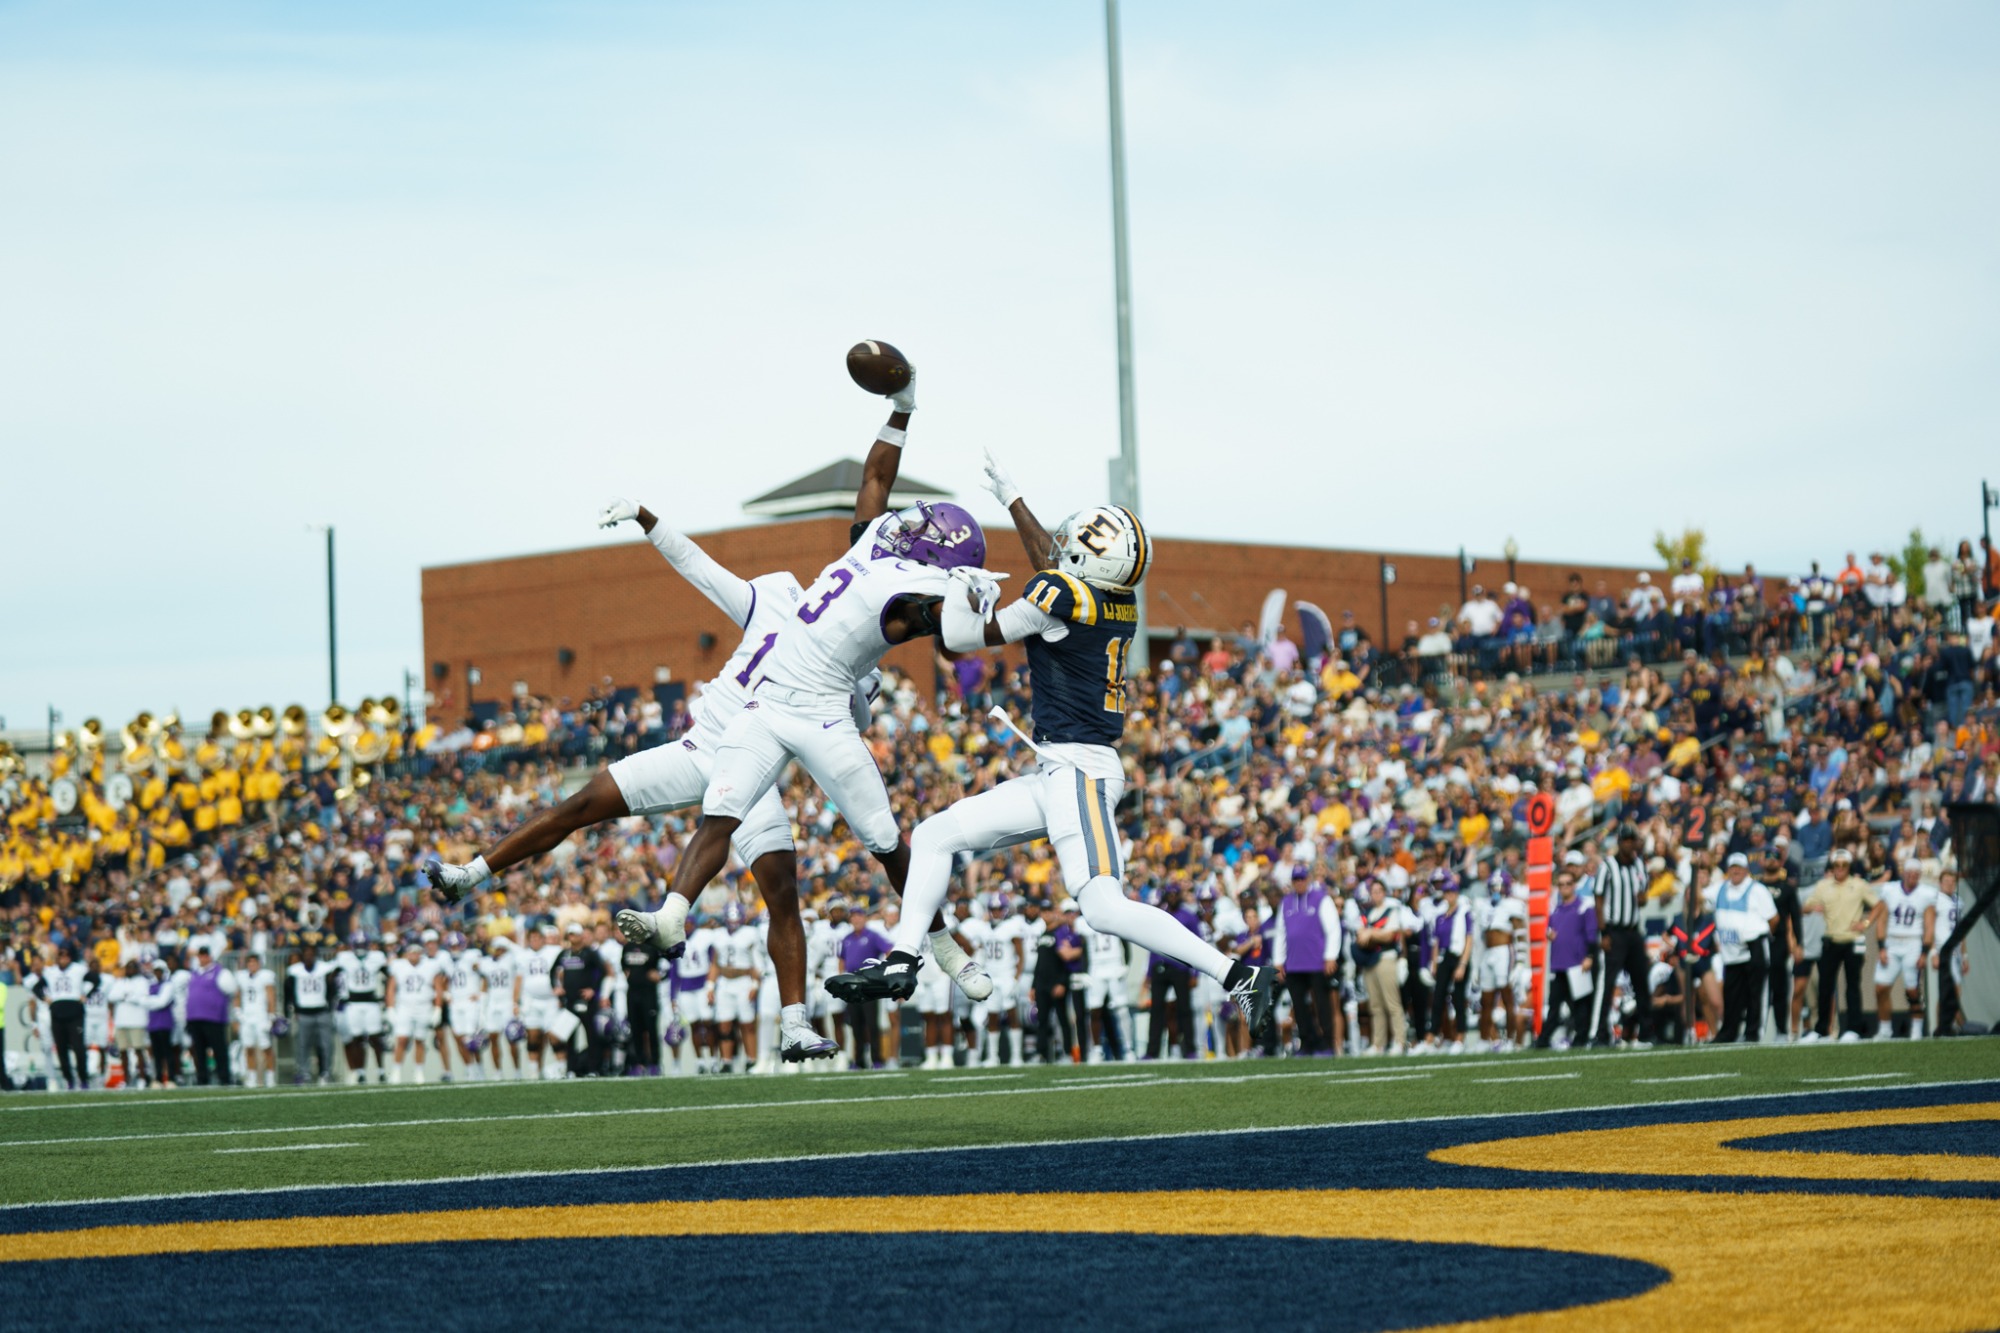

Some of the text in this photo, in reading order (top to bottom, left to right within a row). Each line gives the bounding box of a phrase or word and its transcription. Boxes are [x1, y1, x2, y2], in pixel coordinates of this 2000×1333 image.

[950, 524, 972, 545] 3
[796, 567, 854, 625] 3
[1026, 579, 1061, 614] 11
[734, 631, 779, 693] 1
[1104, 636, 1132, 714] 11
[1687, 805, 1705, 842] 2
[883, 963, 910, 976] NIKE
